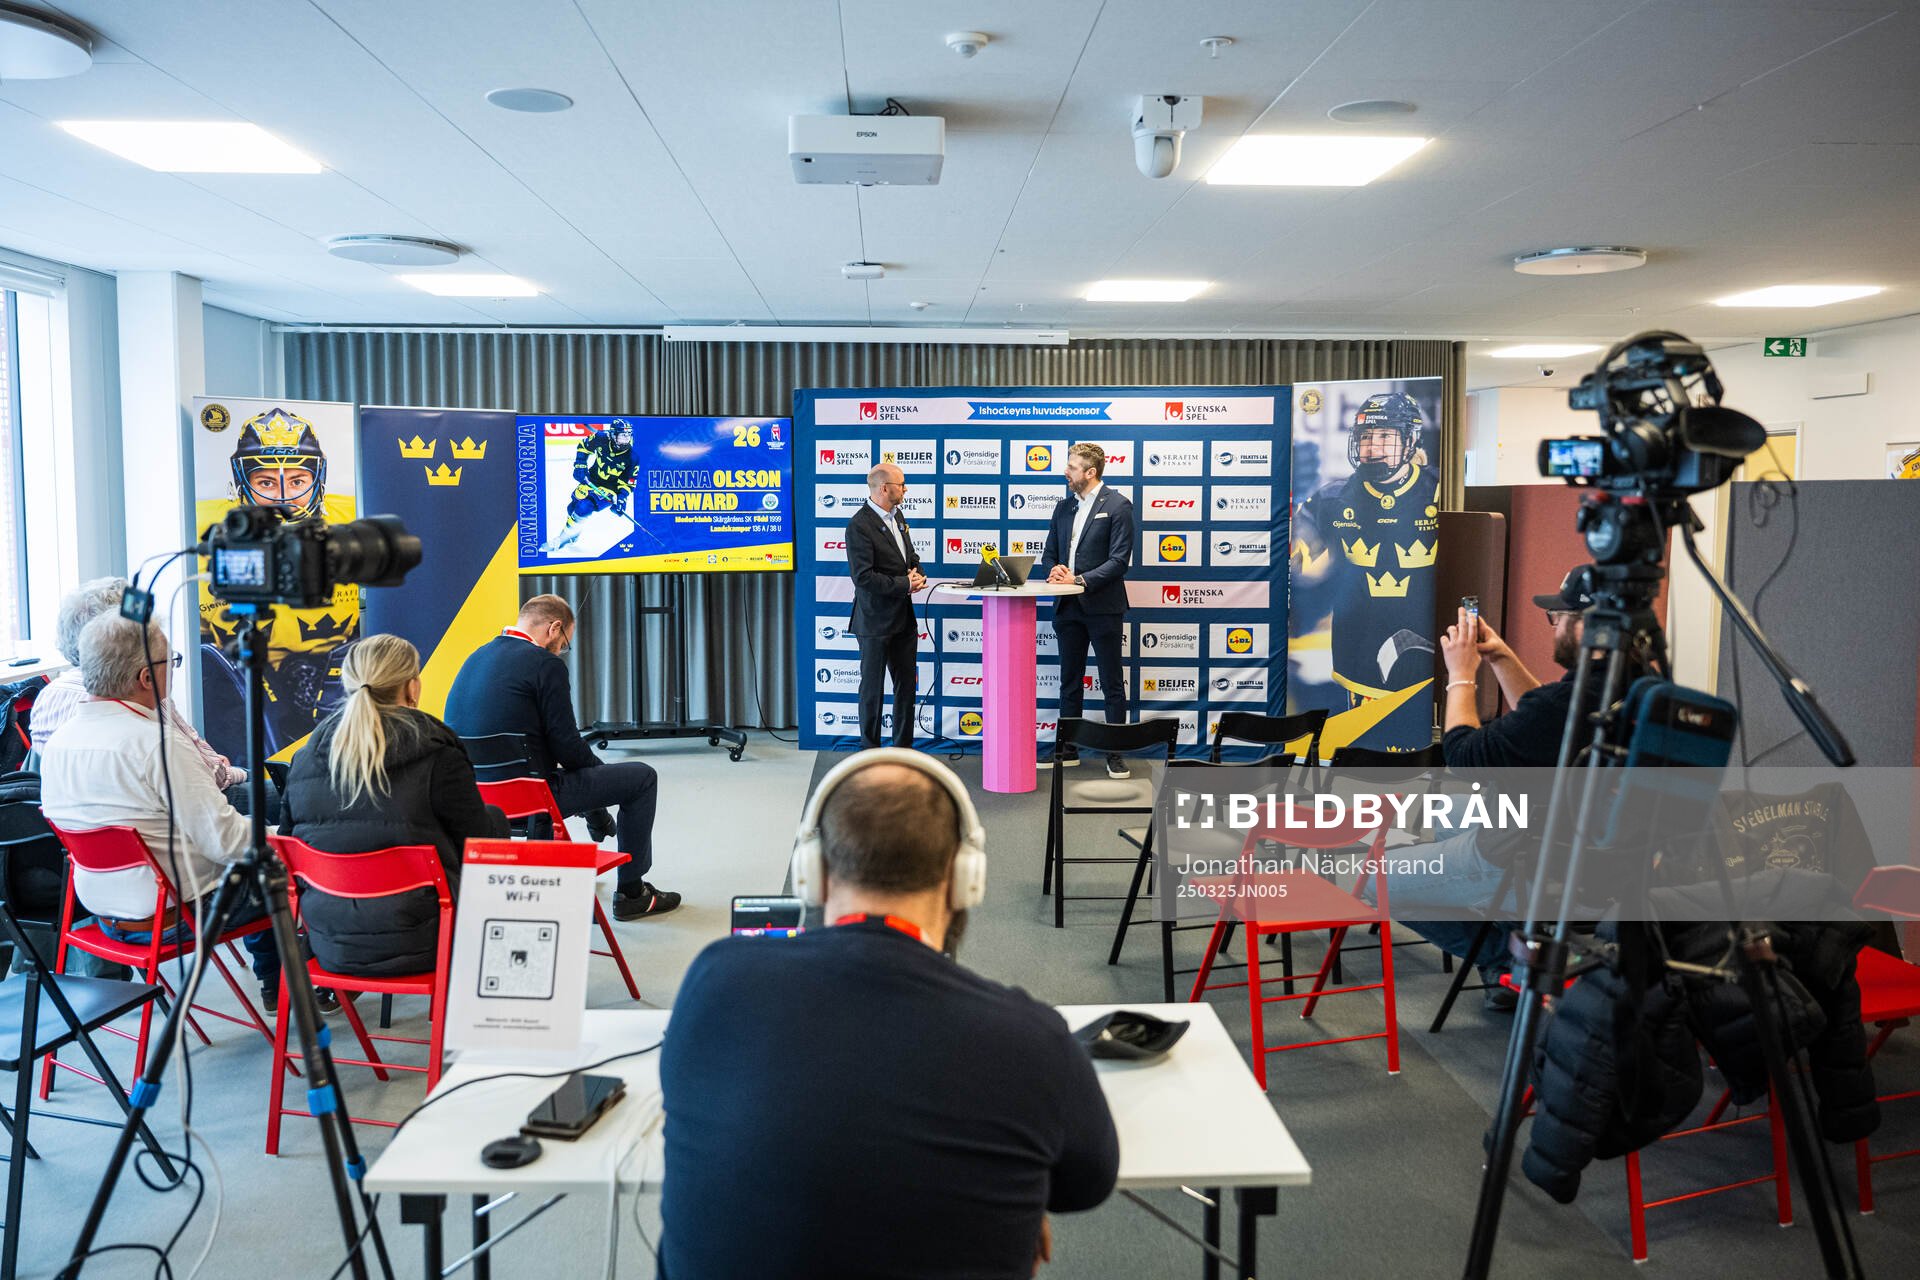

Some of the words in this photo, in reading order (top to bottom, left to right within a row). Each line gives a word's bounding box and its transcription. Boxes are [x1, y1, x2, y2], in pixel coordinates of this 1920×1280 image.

[980, 407, 1031, 416] Ishockeyns
[1033, 407, 1099, 416] huvudsponsor
[1186, 405, 1227, 413] SVENSKA
[880, 413, 900, 421] SPEL
[1186, 413, 1207, 421] SPEL
[734, 425, 761, 447] 26
[897, 452, 932, 461] BEIJER
[963, 451, 999, 459] Gjensidige
[963, 458, 997, 467] Försäkring
[649, 470, 712, 489] HANNA
[713, 470, 781, 489] OLSSON
[518, 424, 539, 558] DAMKRONORNA
[650, 493, 738, 511] FORWARD
[960, 497, 996, 505] BEIJER
[1152, 500, 1195, 508] CCM
[1027, 542, 1043, 550] BEI
[1183, 589, 1224, 597] SVENSKA
[1160, 634, 1197, 642] Gjensidige
[1160, 641, 1194, 650] Försäkring
[1158, 680, 1195, 688] BEIJER
[488, 874, 516, 886] SVS
[521, 876, 561, 887] Guest
[506, 892, 540, 902] Wi-Fi
